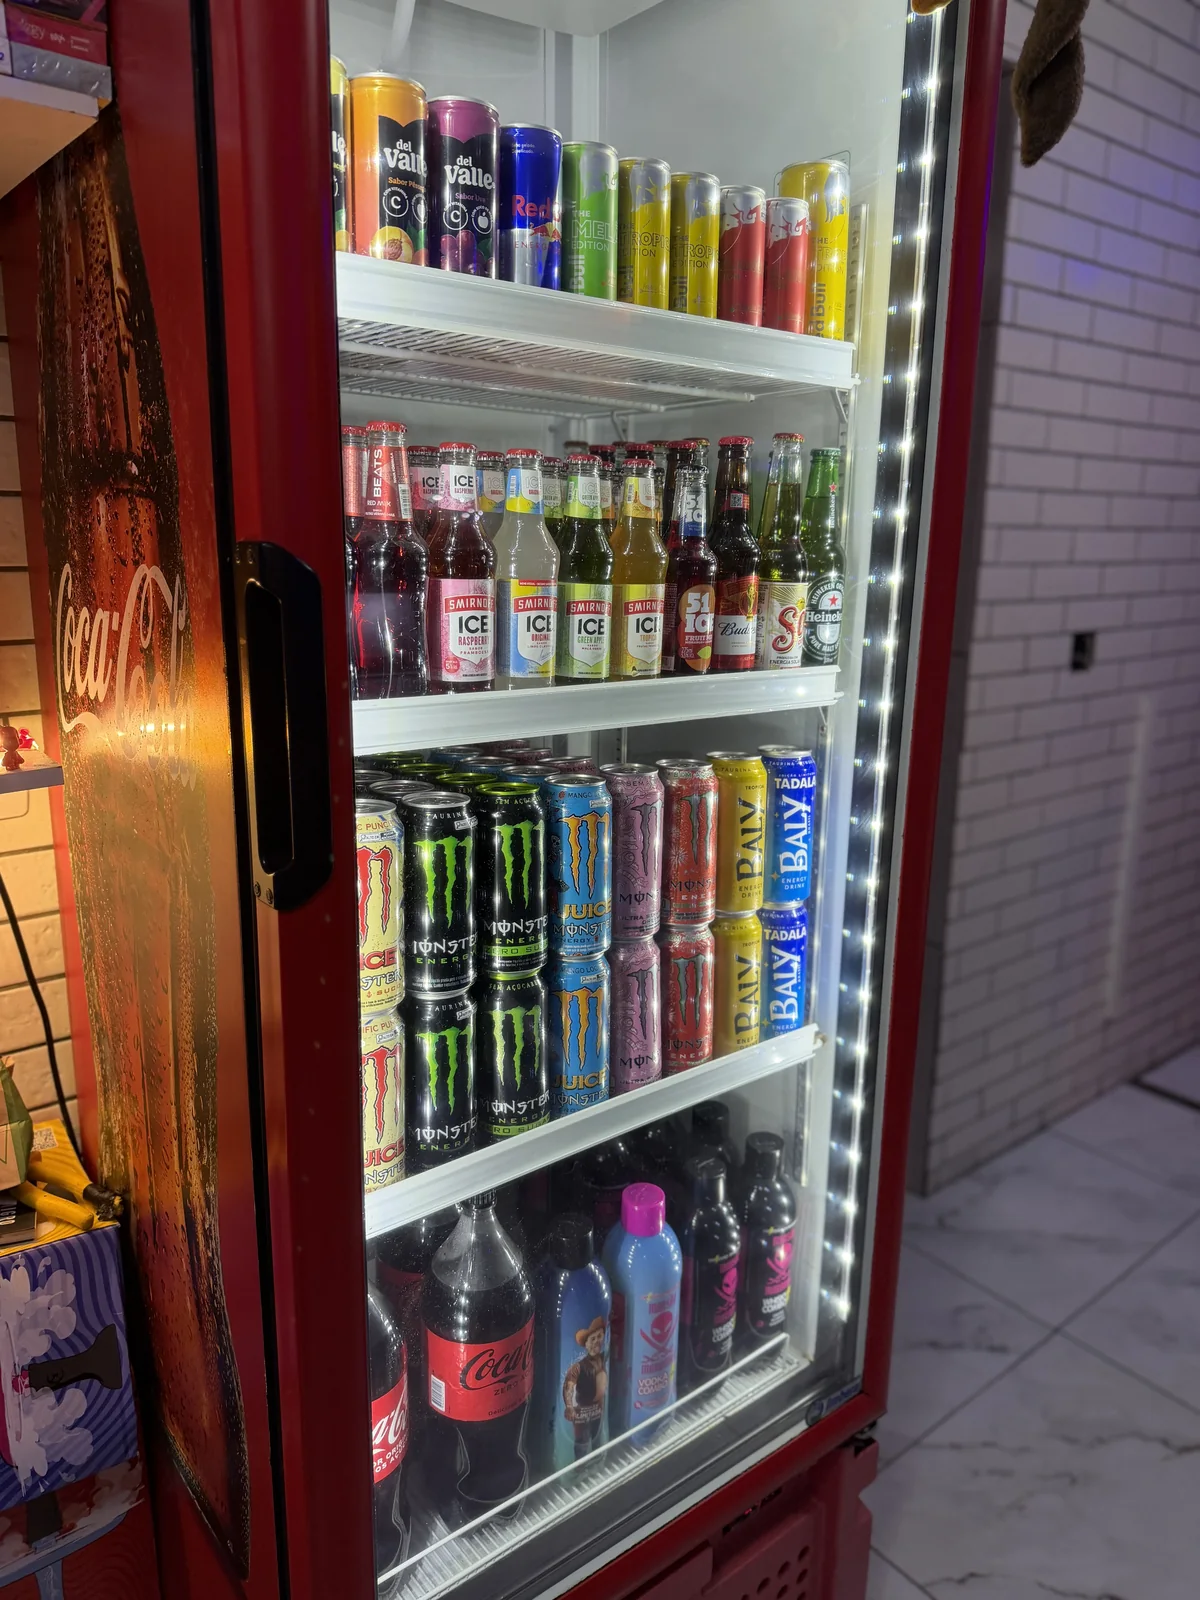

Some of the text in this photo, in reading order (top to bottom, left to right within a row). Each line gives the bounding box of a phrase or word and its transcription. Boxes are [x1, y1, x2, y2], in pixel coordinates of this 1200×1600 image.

[396, 139, 412, 152] del
[383, 147, 427, 178] Valle
[456, 155, 473, 167] del
[388, 177, 408, 186] Sabor
[444, 165, 493, 190] Valle
[391, 196, 401, 209] C
[512, 194, 550, 219] Red
[450, 210, 461, 222] C
[571, 241, 610, 252] EDITION
[568, 254, 585, 290] Bull
[672, 259, 709, 269] EDITION
[808, 283, 826, 317] Bull
[373, 449, 383, 497] BEATS
[454, 475, 474, 487] ICE
[422, 476, 439, 488] ICE
[811, 582, 835, 605] HEINEKEN
[686, 592, 710, 613] 51
[458, 615, 489, 634] ICE
[526, 615, 552, 633] ICE
[577, 618, 605, 635] ICE
[809, 635, 835, 652] PURE MALT
[774, 776, 816, 790] TADALA
[567, 791, 592, 799] MANGO
[735, 797, 765, 882] BALY
[780, 794, 811, 874] BALY
[781, 876, 807, 884] ENERGY
[558, 899, 611, 919] JUICE
[764, 926, 807, 942] TADALA
[489, 983, 504, 991] SEM
[769, 945, 801, 1022] BALY
[638, 1372, 668, 1387] VODKA
[494, 1380, 518, 1396] ZERO
[375, 1462, 387, 1473] OS
